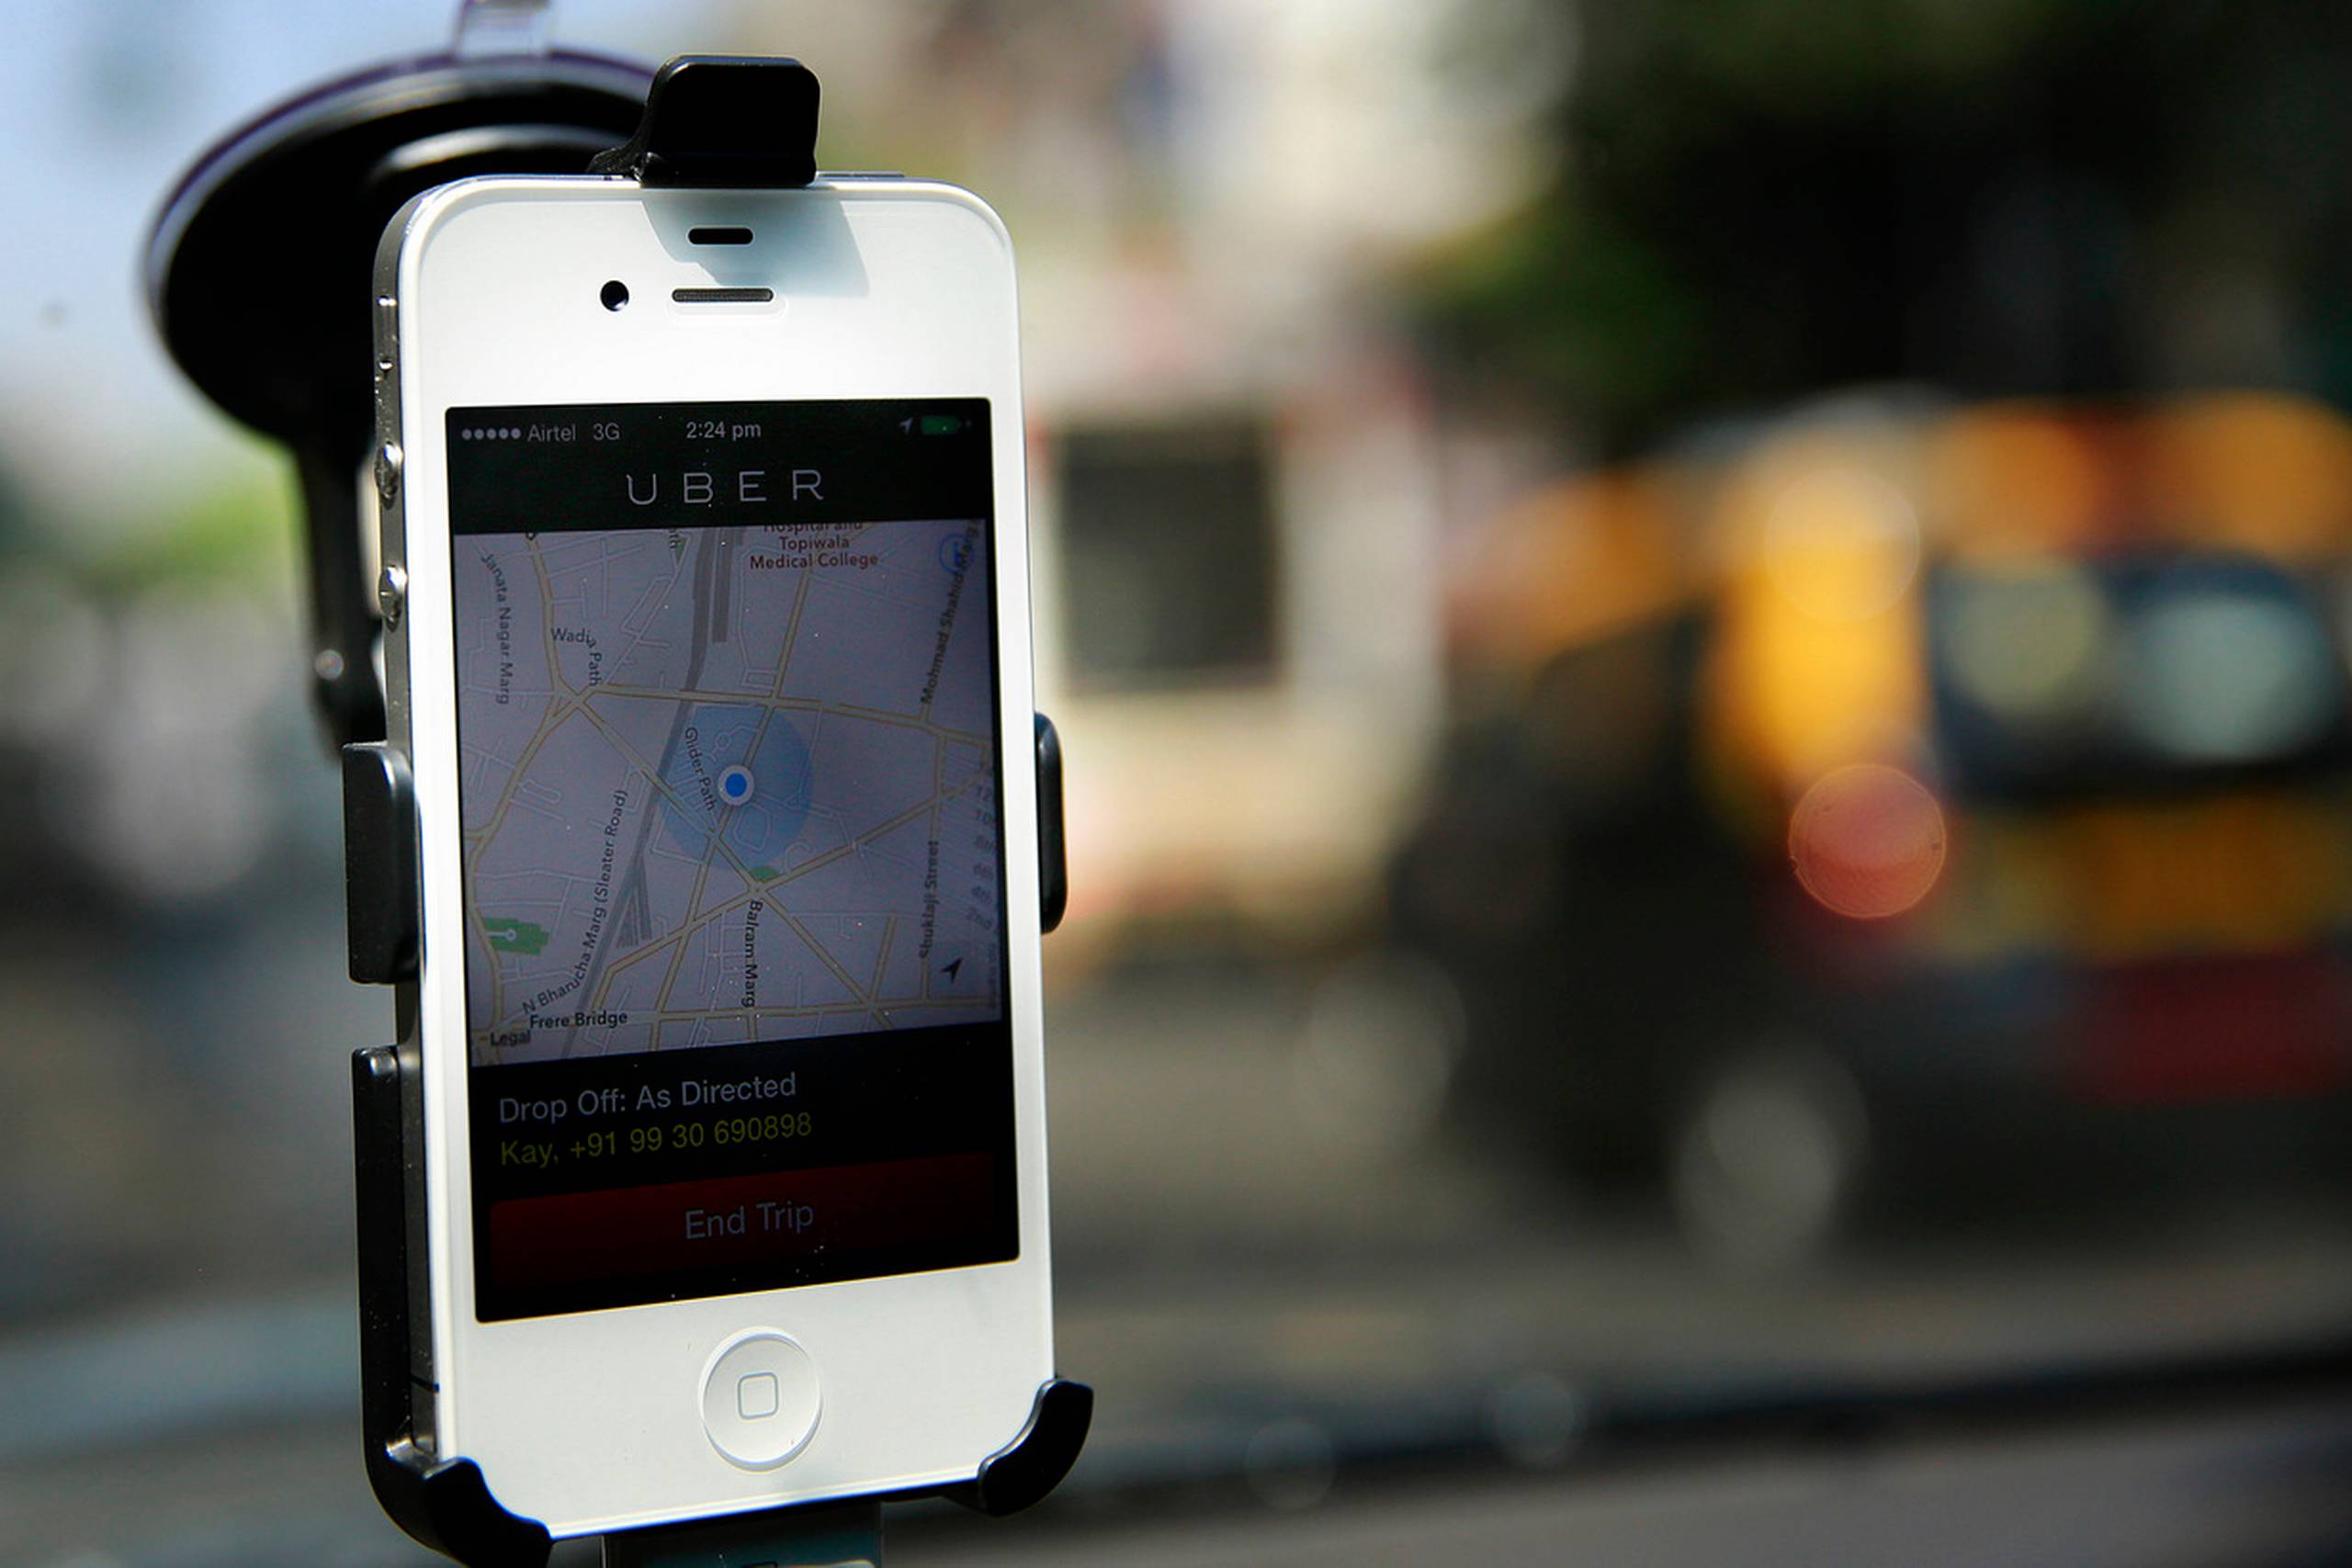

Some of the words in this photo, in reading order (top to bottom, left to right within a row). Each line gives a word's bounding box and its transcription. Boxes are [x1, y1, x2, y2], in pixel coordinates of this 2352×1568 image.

[527, 423, 577, 442] Airtel
[593, 422, 621, 441] 3G
[685, 421, 727, 439] 2:24
[732, 423, 763, 442] pm
[626, 468, 824, 505] UBER
[750, 554, 813, 570] Medical
[817, 552, 878, 570] College
[779, 535, 851, 553] Topiwala
[481, 553, 508, 603] Janata
[496, 606, 512, 658] Nagar
[550, 627, 596, 649] Wadia
[588, 652, 603, 686] Path
[495, 661, 514, 705] Marg
[684, 727, 705, 775] Glider
[698, 776, 718, 811] Path
[522, 998, 536, 1014] N
[537, 953, 591, 1007] Bharucha
[582, 907, 607, 949] Marg
[604, 789, 628, 838] Road)
[744, 900, 763, 958] Balram
[741, 964, 758, 1008] Marg
[489, 1030, 531, 1047] Legal
[529, 1014, 570, 1030] Frere
[574, 1010, 628, 1030] Bridge
[499, 1097, 568, 1125] Drop
[578, 1088, 627, 1116] Off:
[636, 1085, 672, 1111] As
[681, 1071, 797, 1107] Directed
[571, 1130, 616, 1159] +91
[629, 1126, 663, 1154] 99
[672, 1122, 705, 1148] 30
[714, 1111, 813, 1145] 690898
[684, 1205, 746, 1240] End
[755, 1200, 814, 1235] Trip
